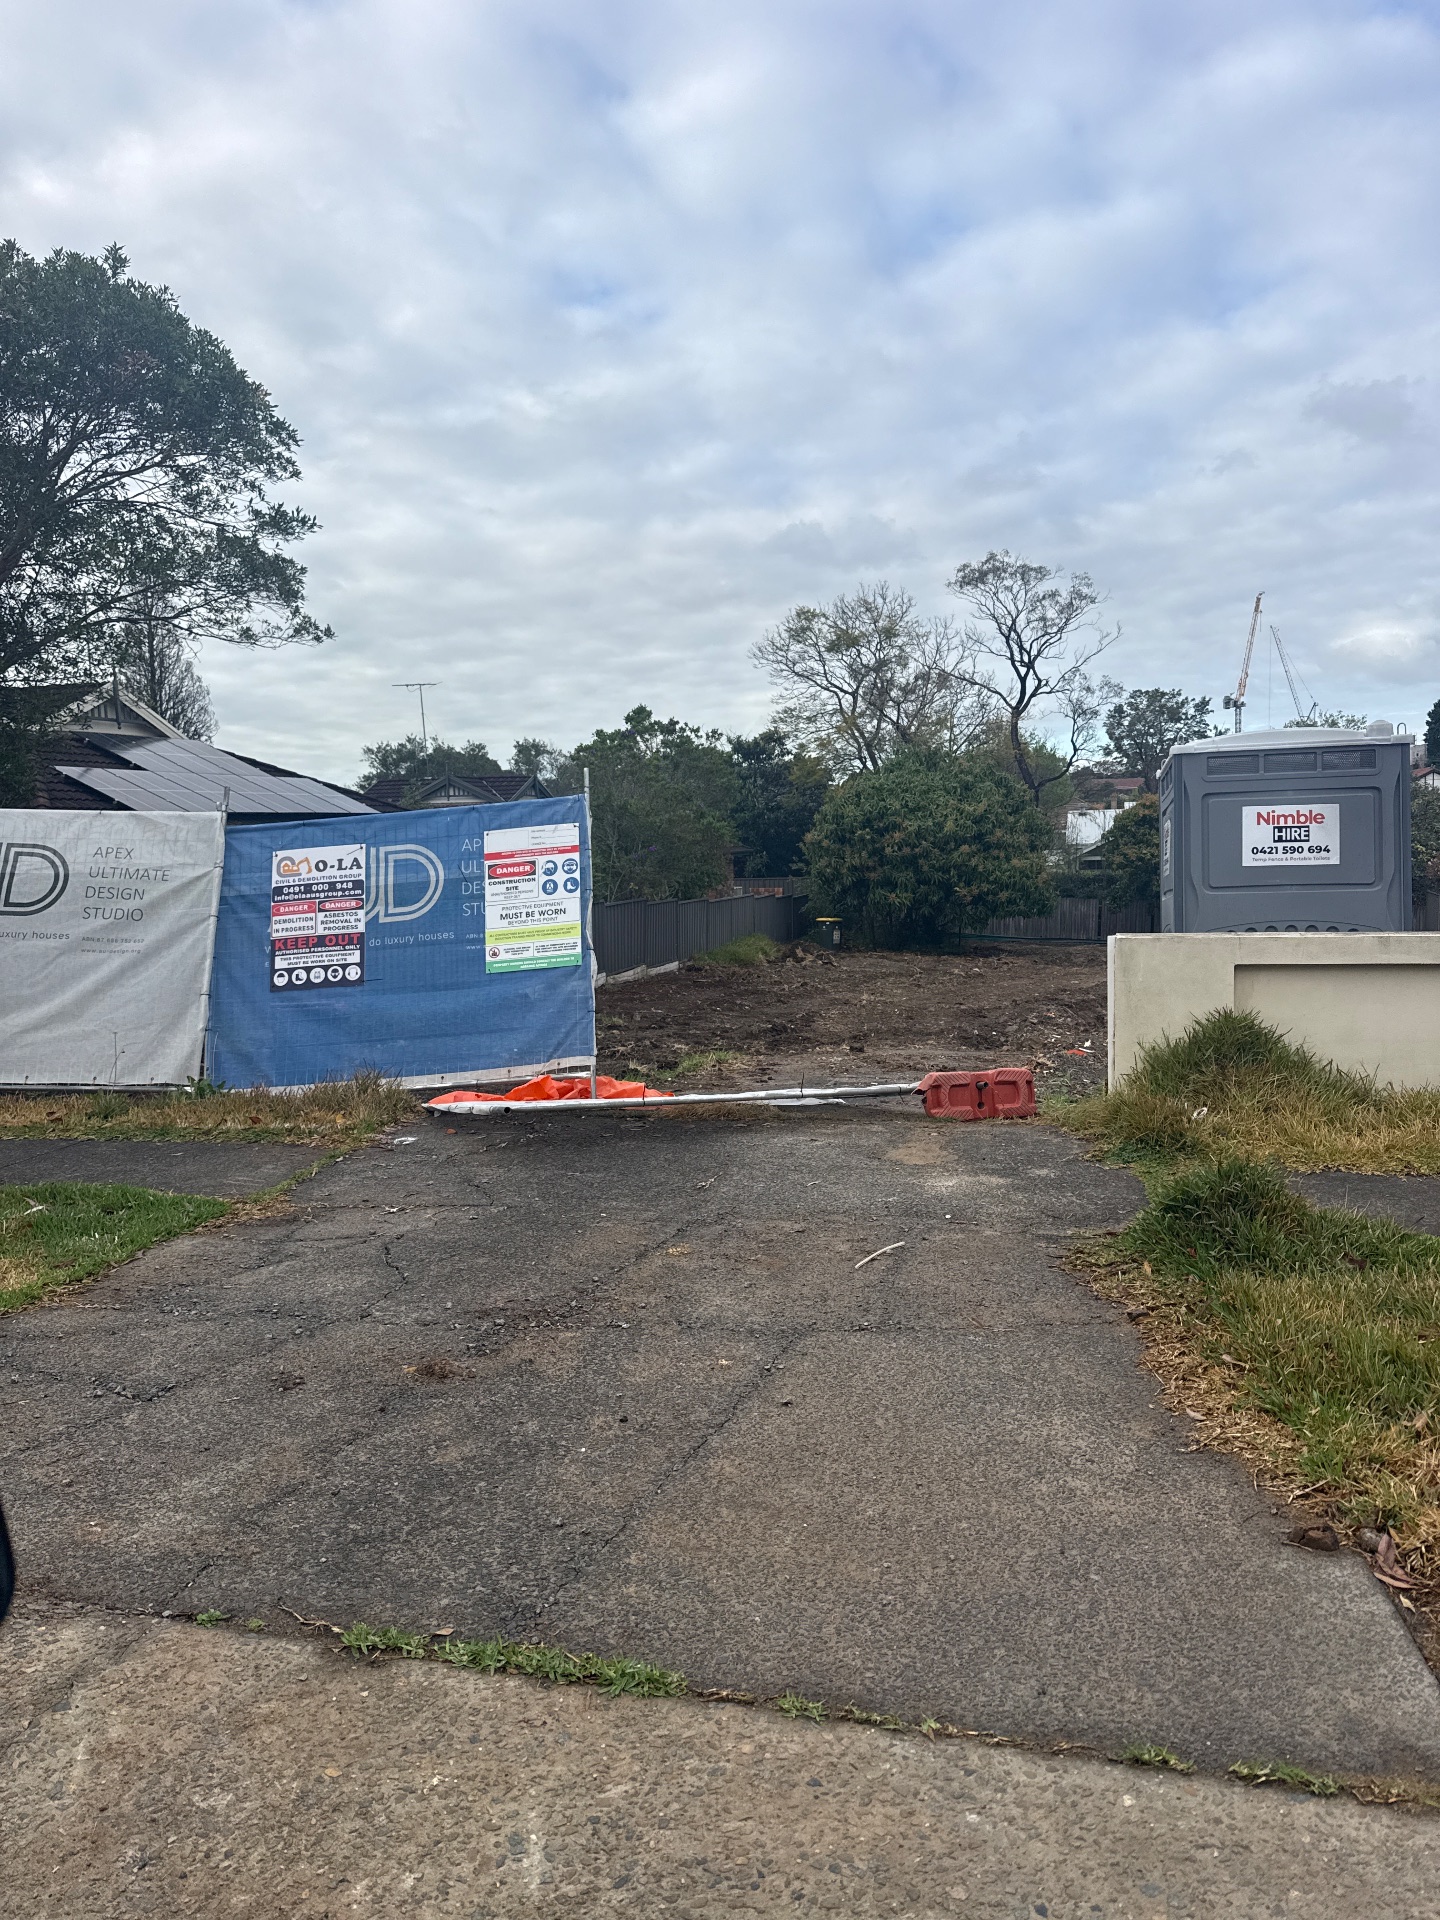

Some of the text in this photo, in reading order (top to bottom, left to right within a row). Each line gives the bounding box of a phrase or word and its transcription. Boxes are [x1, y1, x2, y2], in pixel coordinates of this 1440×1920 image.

[1256, 809, 1326, 826] Nimble
[1274, 827, 1309, 841] HIRE
[461, 838, 482, 852] AP
[1251, 844, 1331, 855] 0421 590 694
[92, 846, 135, 860] APEX
[314, 857, 363, 873] O-LA
[496, 865, 531, 875] DANGER
[88, 865, 171, 883] ULTIMATE
[297, 875, 338, 883] DEMOLITION
[282, 885, 305, 894] 0491
[311, 883, 329, 892] 000
[335, 881, 353, 890] 948
[488, 877, 536, 887] CONSTRUCTION
[84, 886, 146, 901] DESIGN
[279, 904, 309, 913] DANGER
[325, 900, 356, 909] DANGER
[501, 901, 564, 912] PROTECTIVE EQUIPMENT
[82, 906, 144, 922] STUDIO
[323, 911, 359, 919] ASBESTOS
[499, 907, 567, 921] MUST BE WORN
[273, 916, 314, 925] DEMOLITION
[320, 918, 353, 926] REMOVAL
[281, 925, 315, 933] PROGRESS
[323, 924, 359, 932] PROGRESS
[0, 930, 70, 941] uxury houses
[369, 930, 455, 947] do luxury houses
[275, 933, 361, 950] KEEP OUT
[275, 947, 310, 956] AUTHORISED
